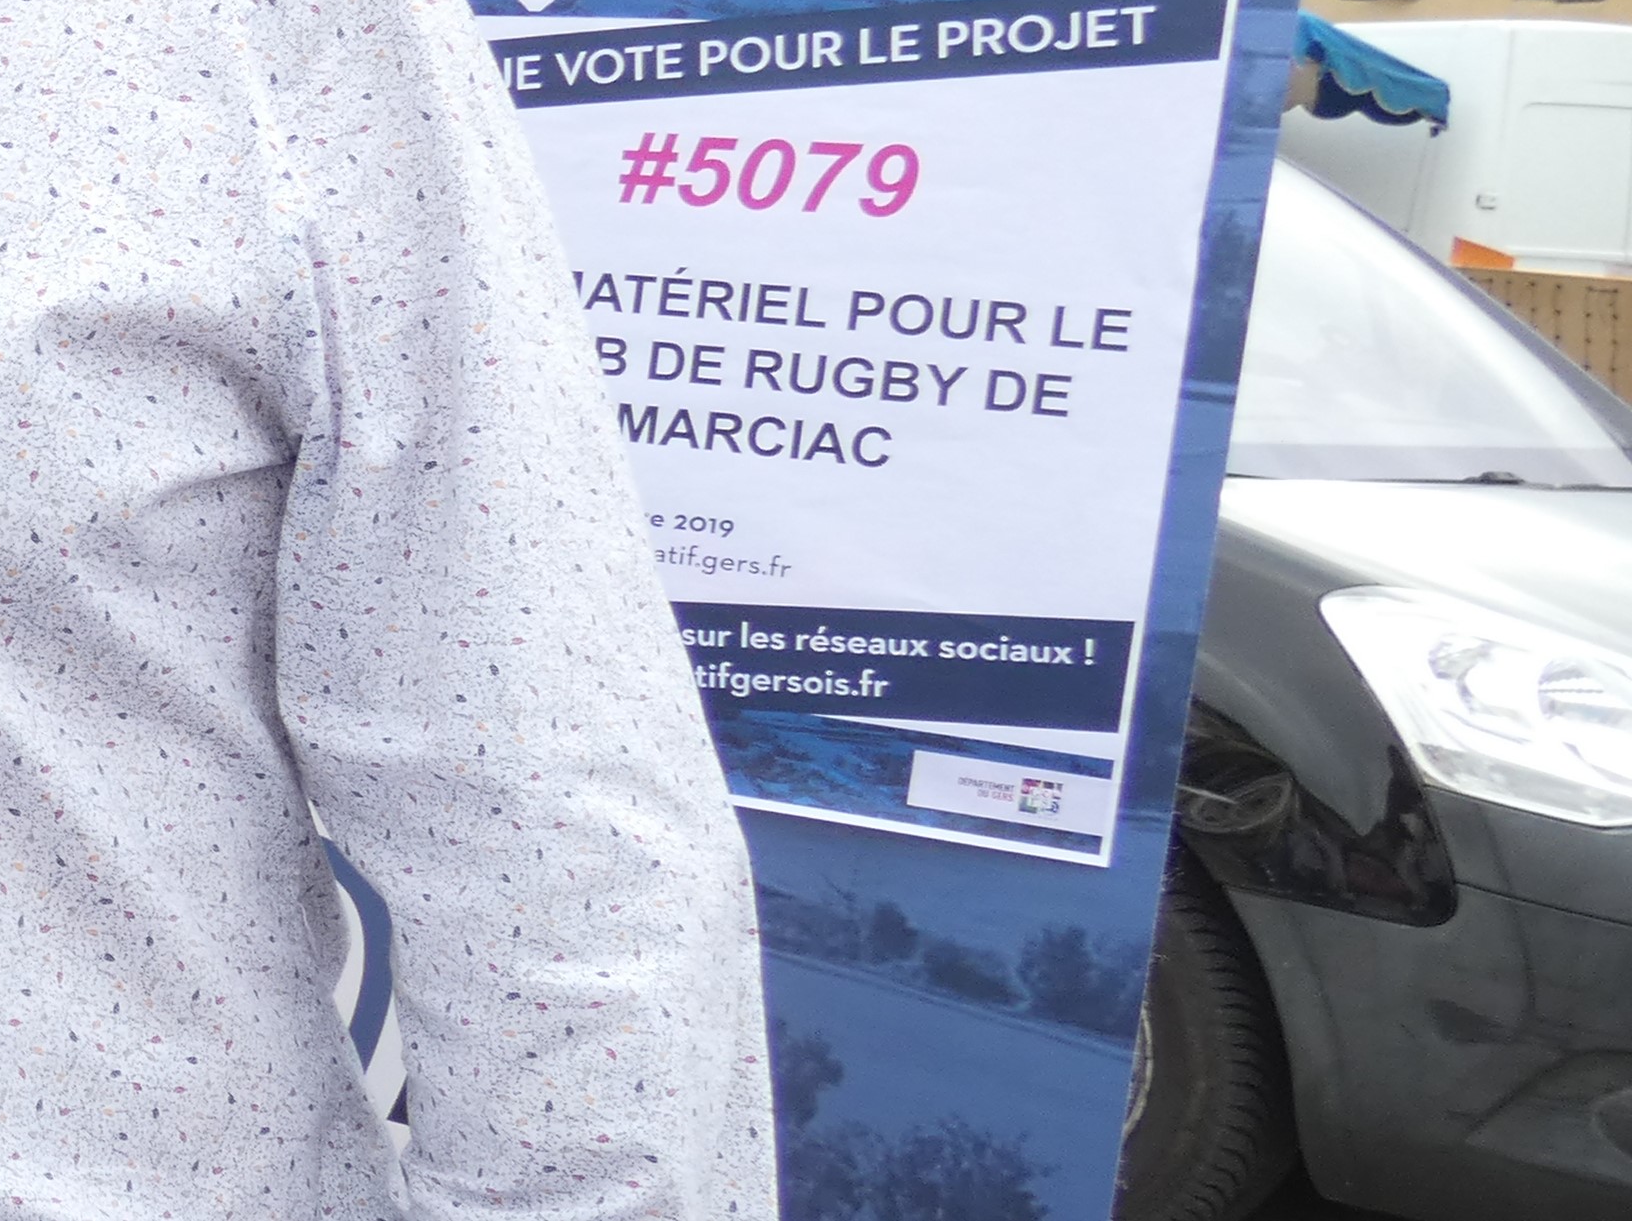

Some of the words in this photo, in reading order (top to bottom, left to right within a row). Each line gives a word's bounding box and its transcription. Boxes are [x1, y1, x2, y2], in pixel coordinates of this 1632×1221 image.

[555, 43, 684, 87] VOTE
[699, 26, 845, 81] POUR
[860, 19, 922, 65] LE
[937, 4, 1157, 59] PROJET
[618, 129, 921, 218] #5079
[847, 291, 1027, 345] POUR
[1051, 303, 1133, 352] LE
[648, 341, 725, 386] DE
[746, 348, 967, 408] RUGBY
[984, 372, 1073, 418] DE
[617, 403, 893, 467] MARCIAC
[674, 514, 734, 538] 2019
[682, 626, 732, 648] sur
[740, 621, 785, 650] les
[794, 625, 929, 657] réseaux
[939, 634, 1072, 668] sociaux
